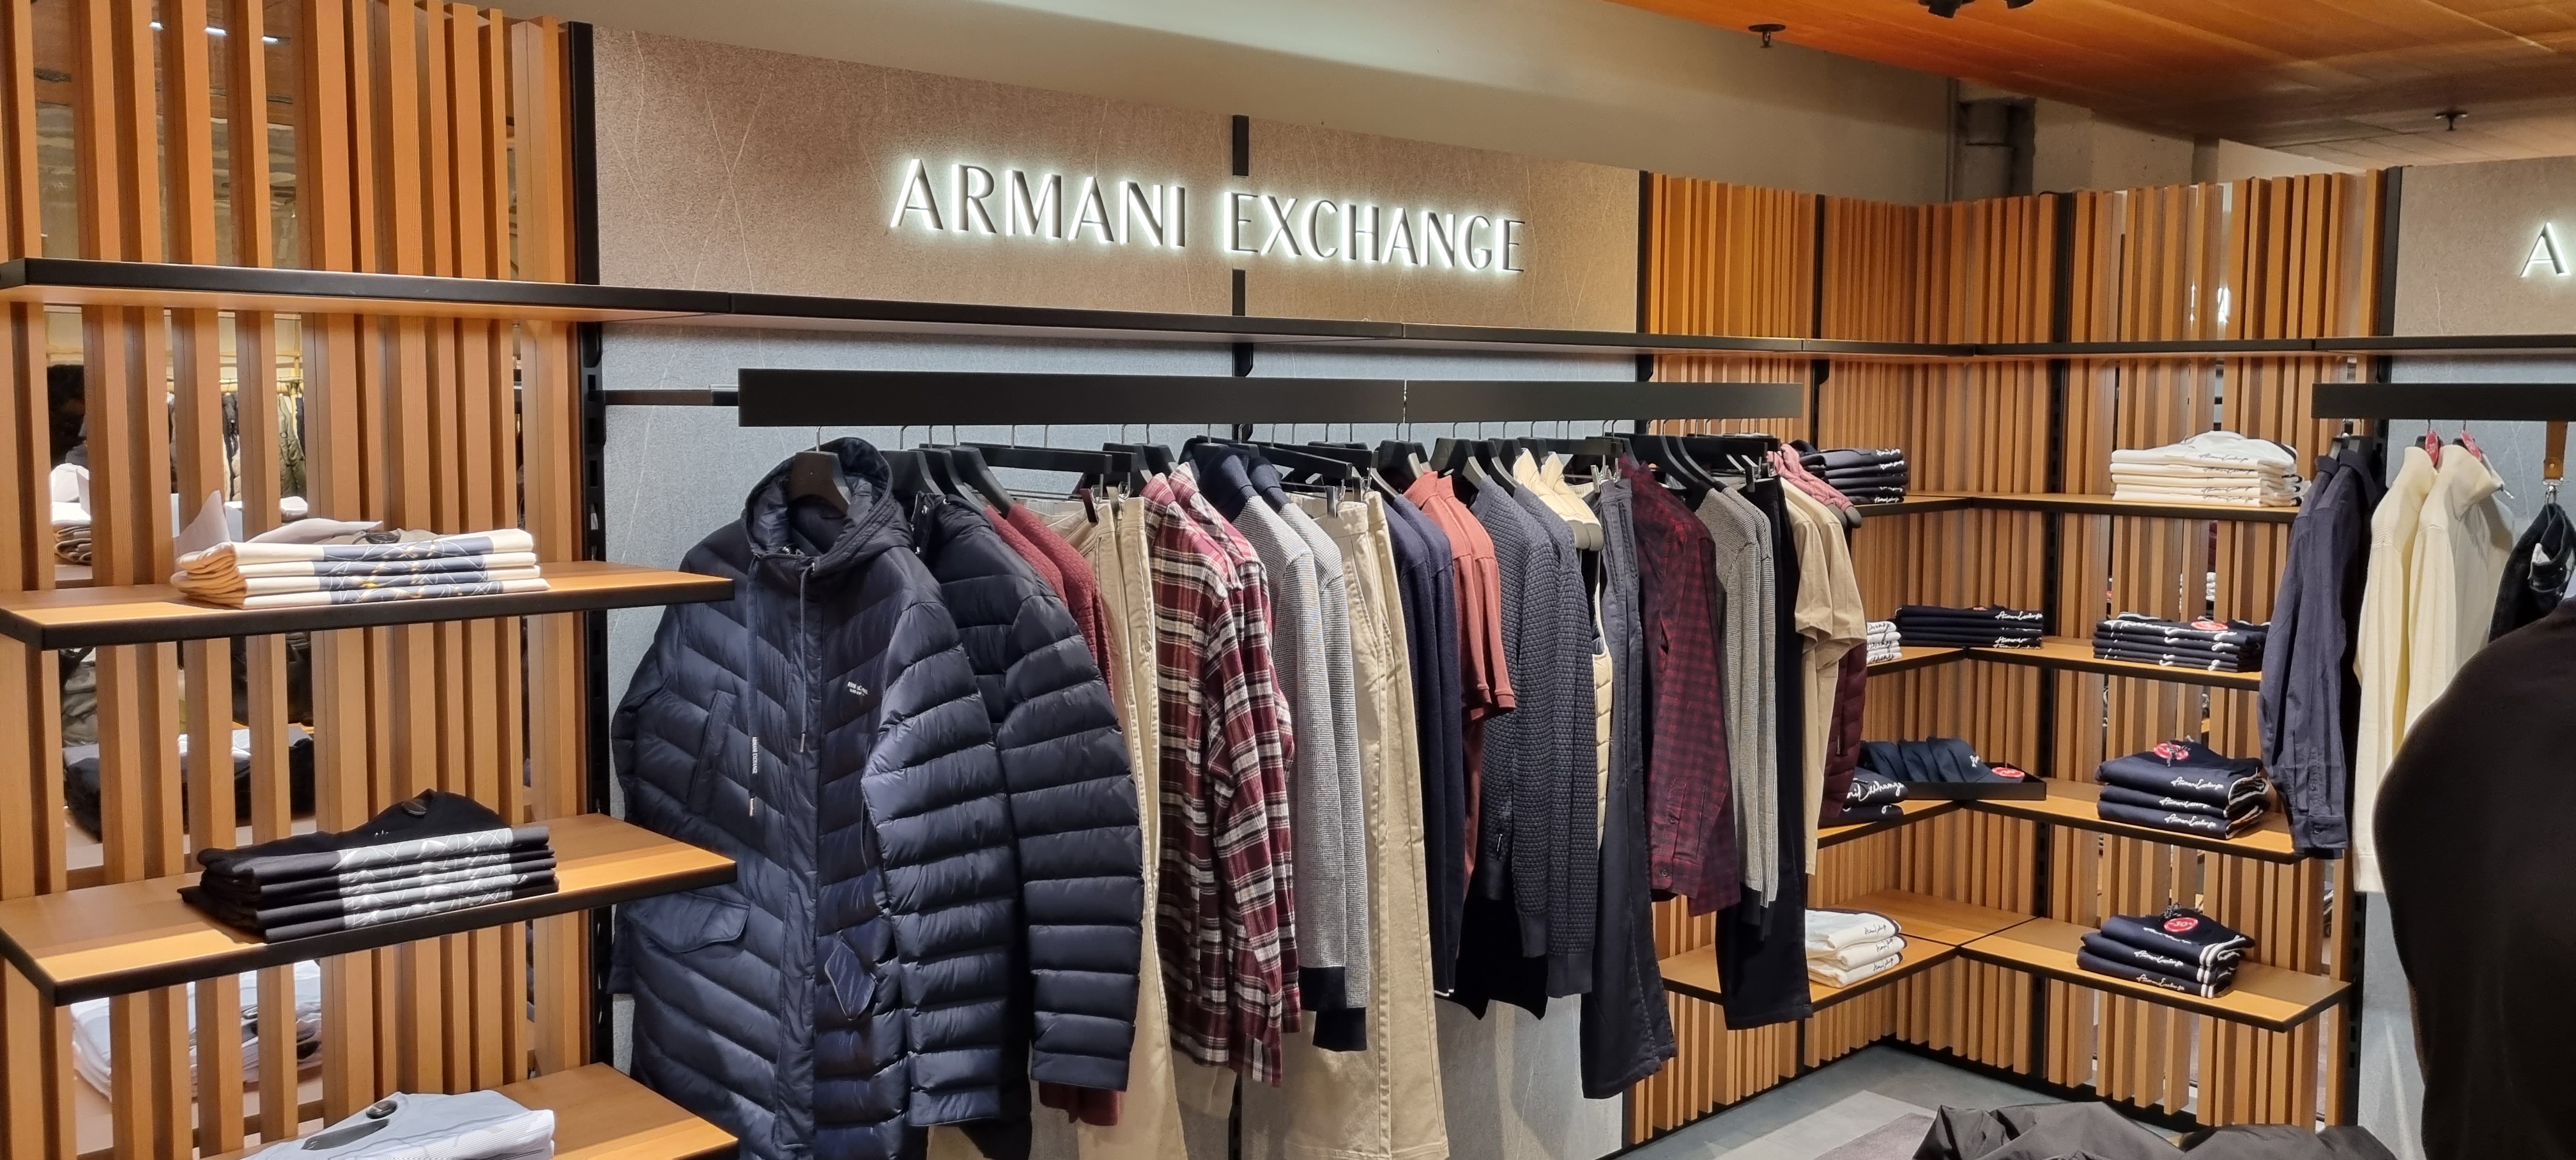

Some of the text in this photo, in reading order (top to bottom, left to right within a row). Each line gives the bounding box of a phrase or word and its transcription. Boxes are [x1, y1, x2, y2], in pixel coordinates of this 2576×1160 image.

[891, 158, 1526, 273] ARMANI EXCHANGE
[2520, 222, 2571, 277] A
